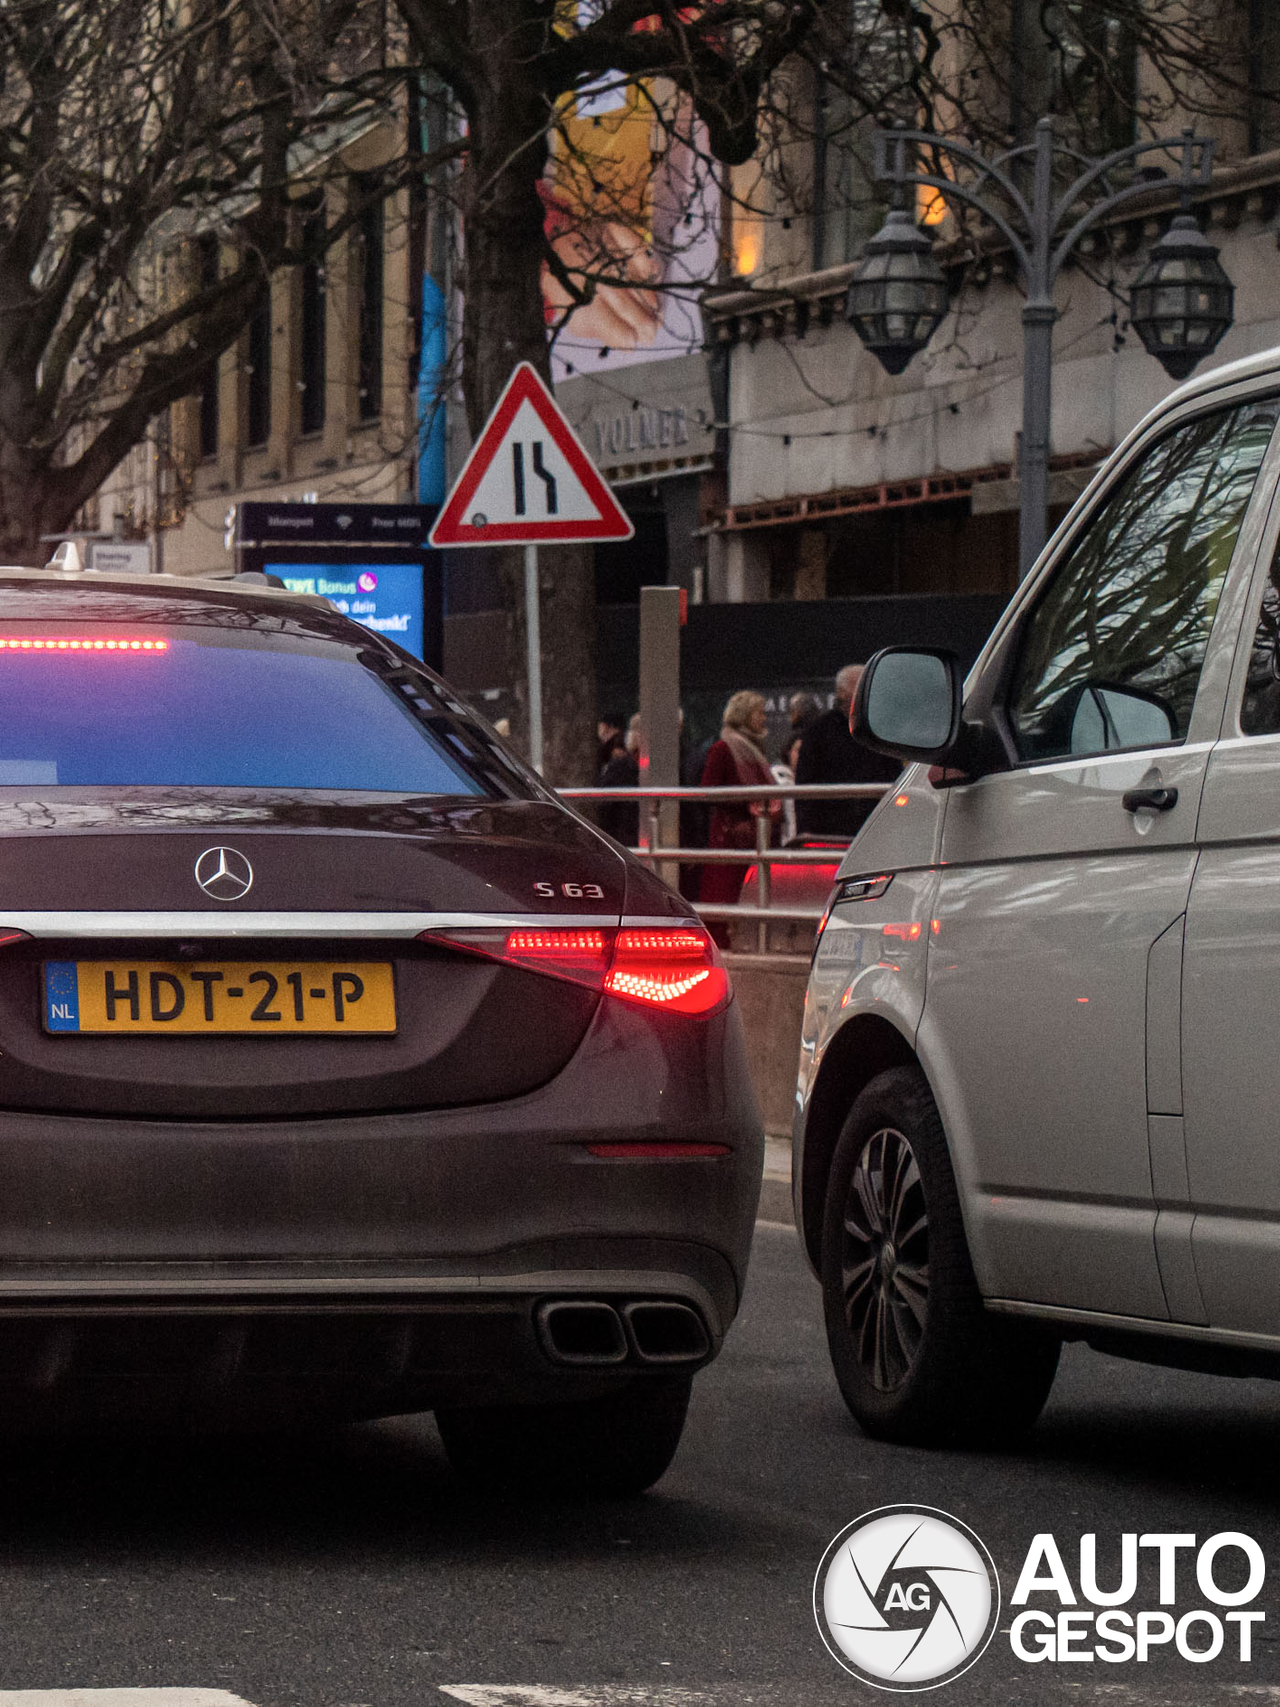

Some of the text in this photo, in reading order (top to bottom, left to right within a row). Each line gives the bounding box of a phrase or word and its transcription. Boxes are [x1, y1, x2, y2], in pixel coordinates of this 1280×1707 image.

[283, 579, 357, 594] EWE Bonus
[351, 600, 376, 613] dein
[534, 883, 604, 898] S 63
[104, 970, 364, 1021] HDT-21-P
[51, 1004, 74, 1018] NL
